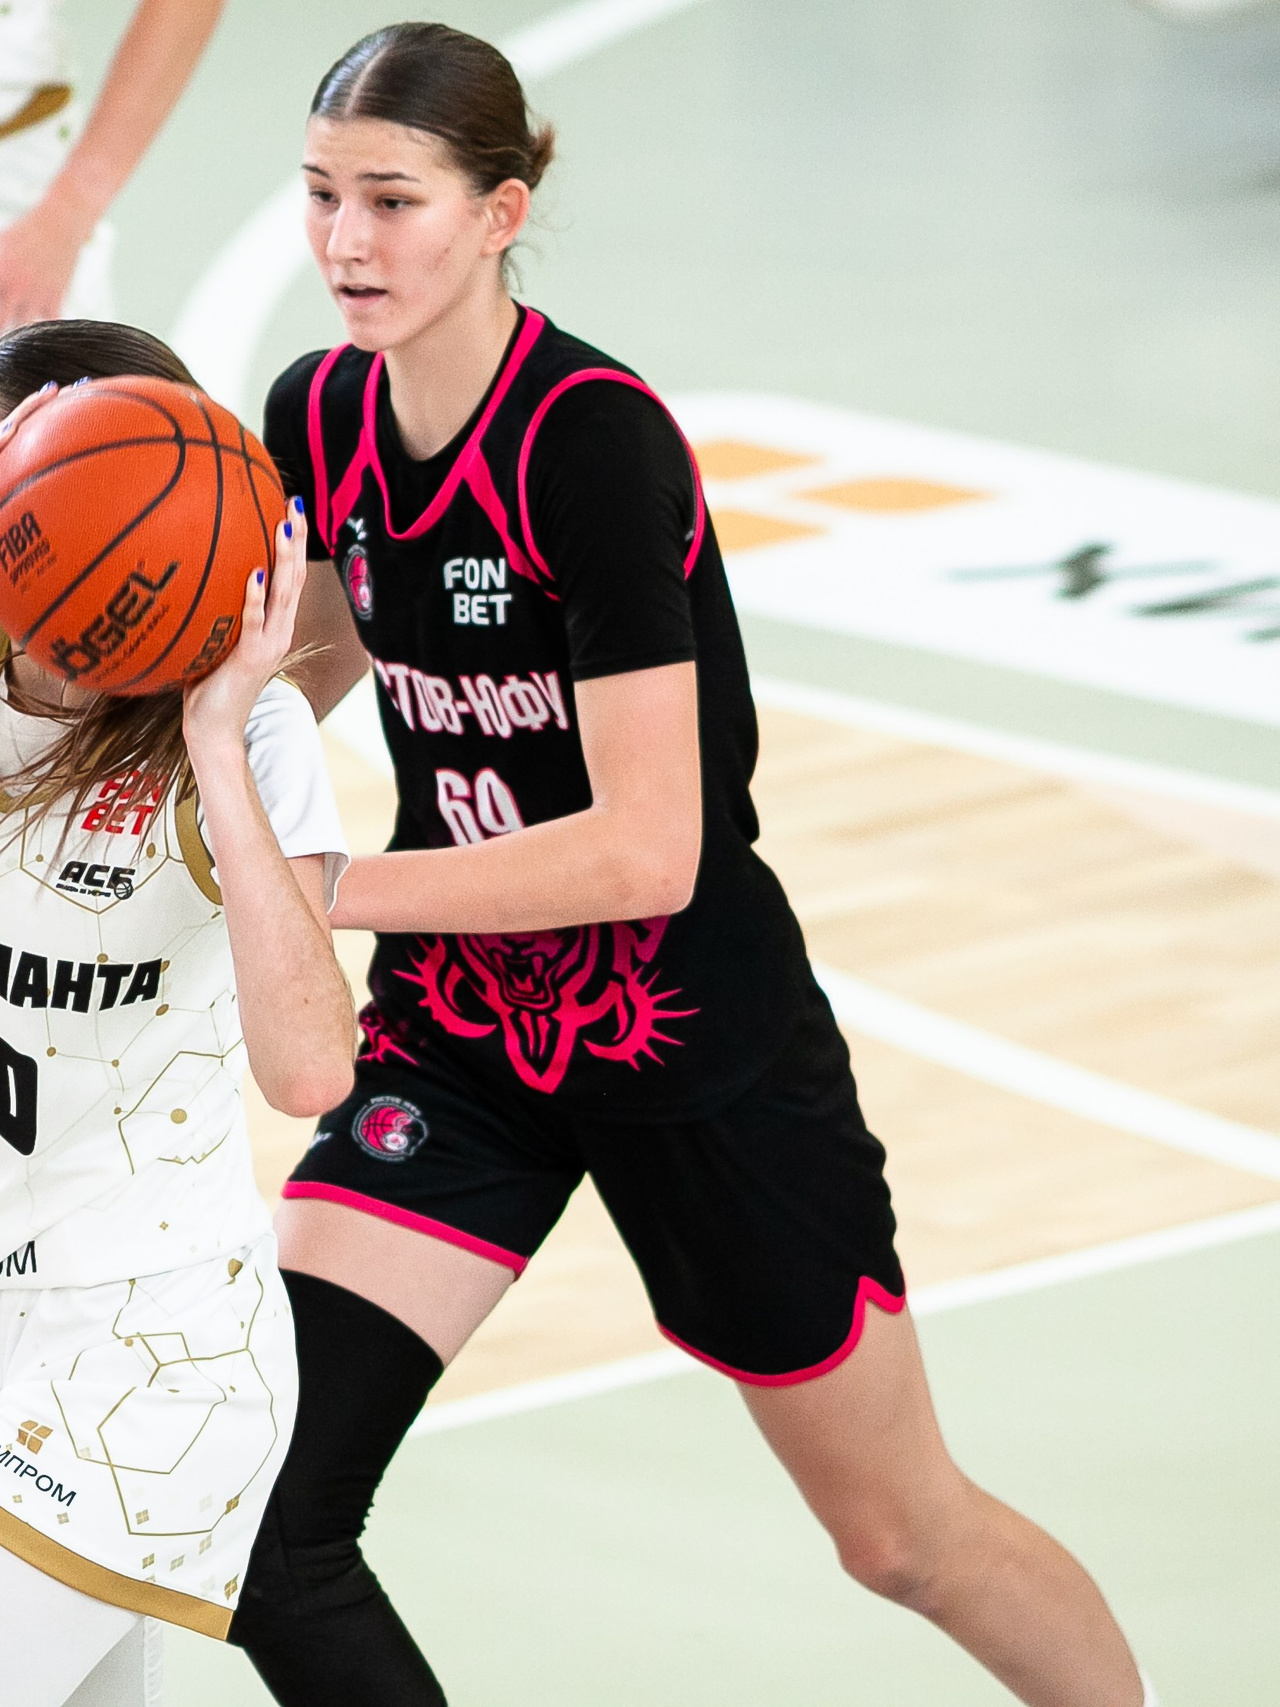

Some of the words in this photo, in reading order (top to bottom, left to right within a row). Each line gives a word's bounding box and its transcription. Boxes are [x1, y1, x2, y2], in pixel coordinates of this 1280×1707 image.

[444, 558, 506, 590] FON
[453, 594, 512, 625] BET
[81, 801, 155, 835] BET
